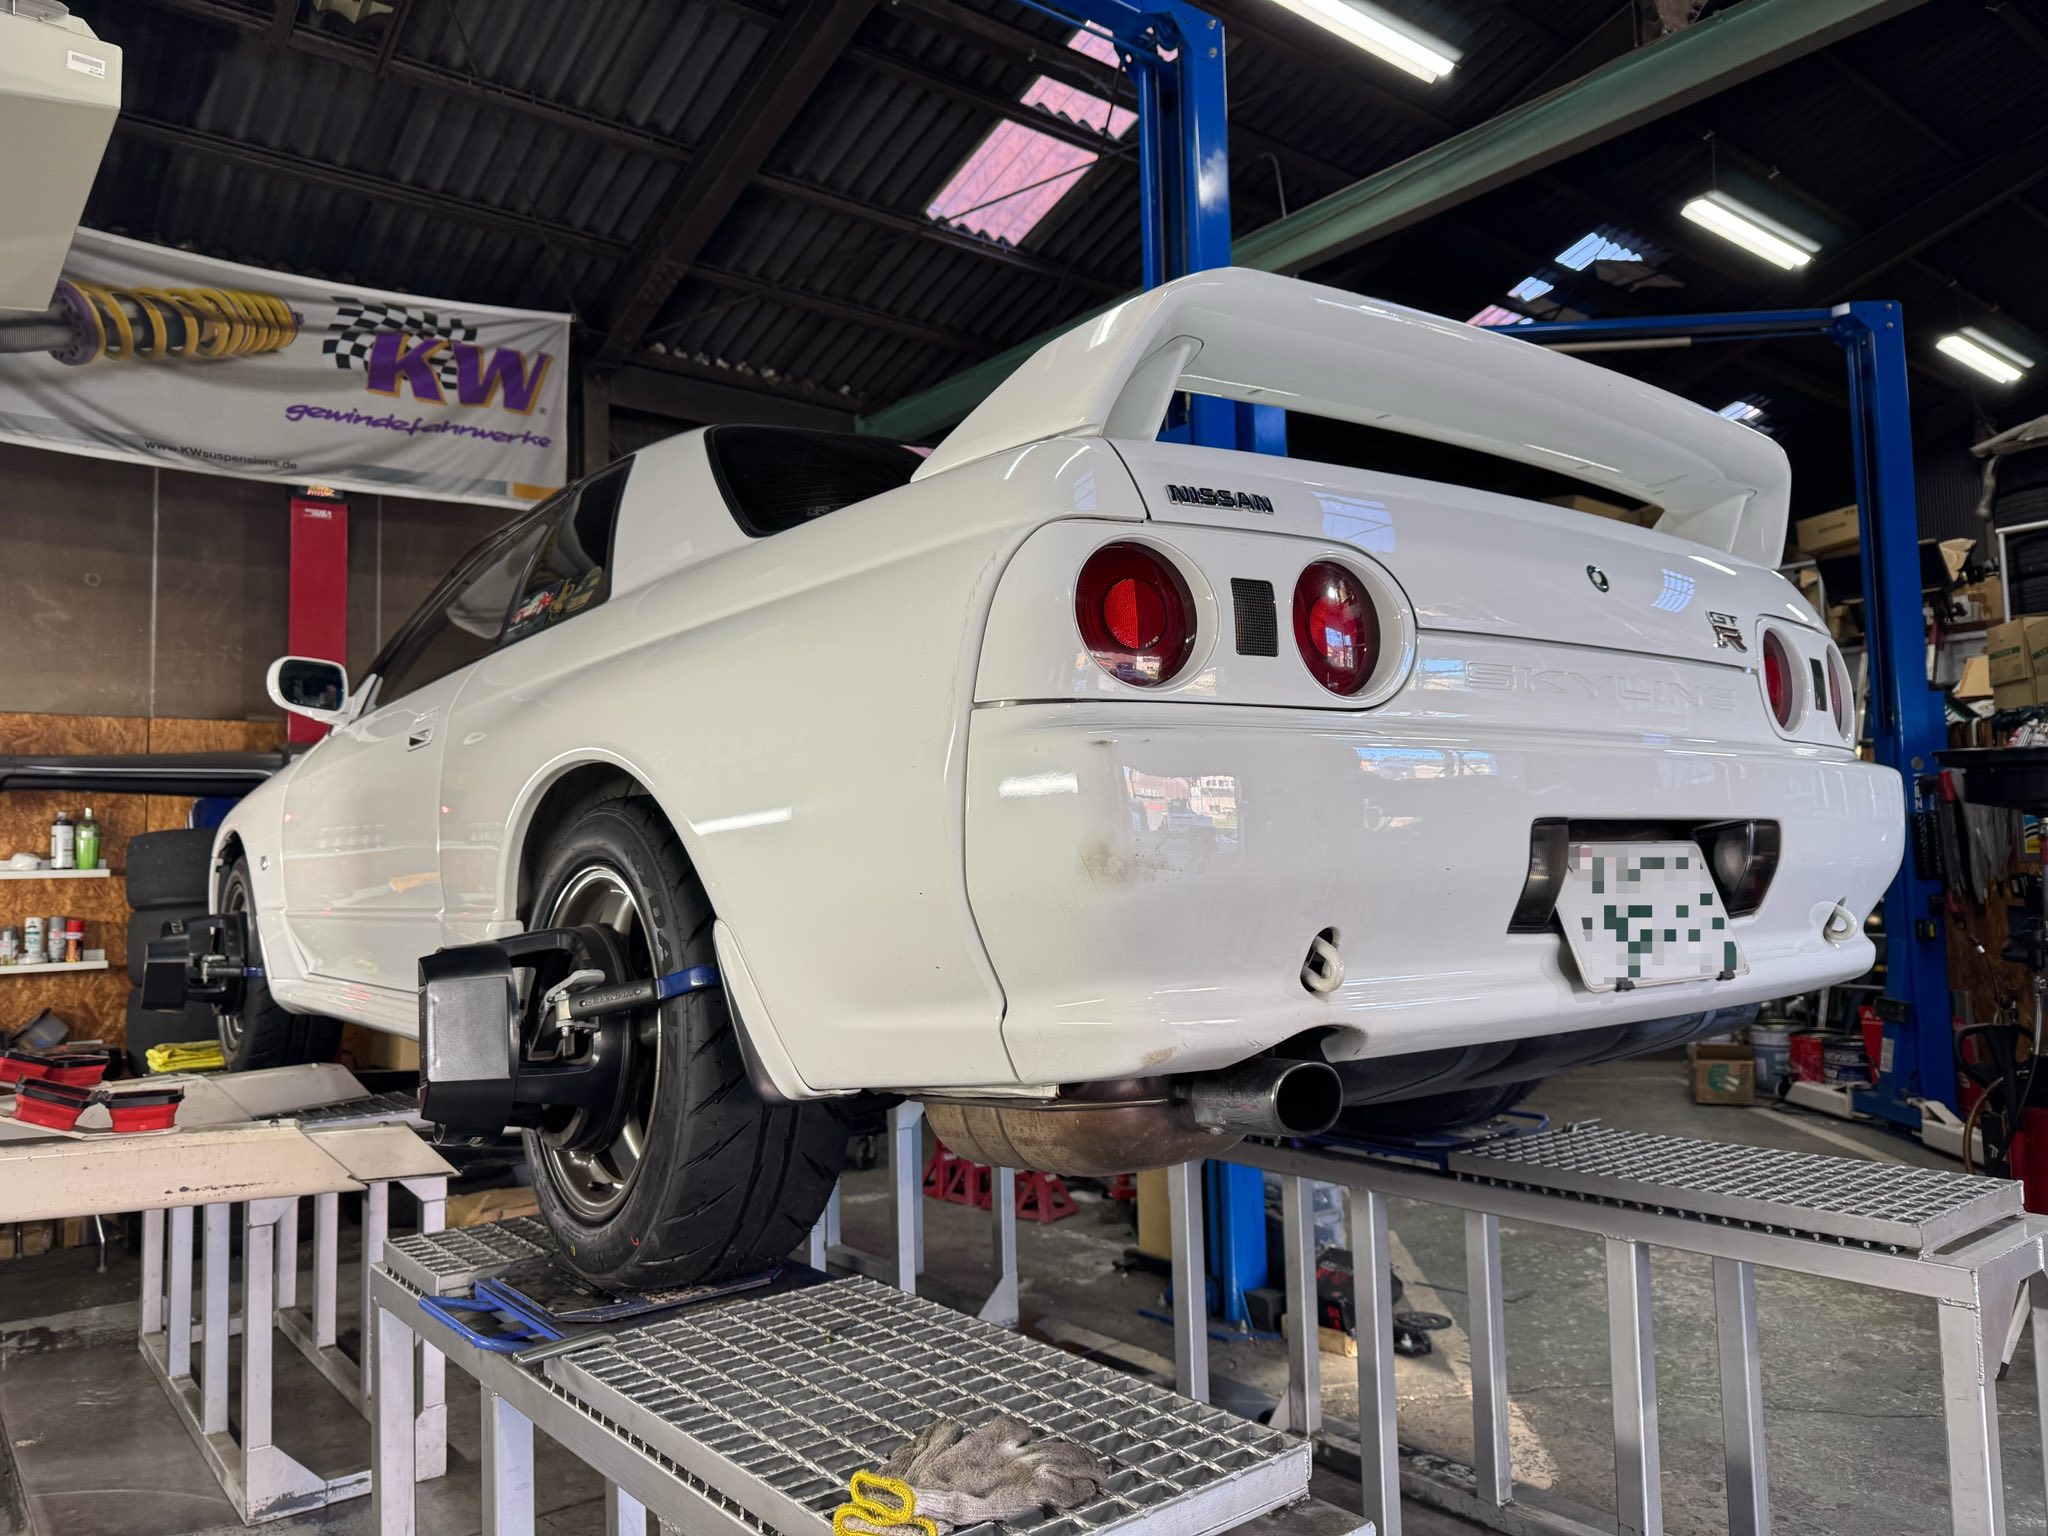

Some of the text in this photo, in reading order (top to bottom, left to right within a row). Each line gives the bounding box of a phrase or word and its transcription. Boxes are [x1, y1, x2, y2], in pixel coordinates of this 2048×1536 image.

[367, 331, 554, 416] KW
[285, 403, 552, 448] gewindefahrwerke
[144, 440, 298, 470] www.KWsuspensions.de
[1165, 484, 1275, 515] NISSAN
[1466, 660, 1737, 712] SKYLINE
